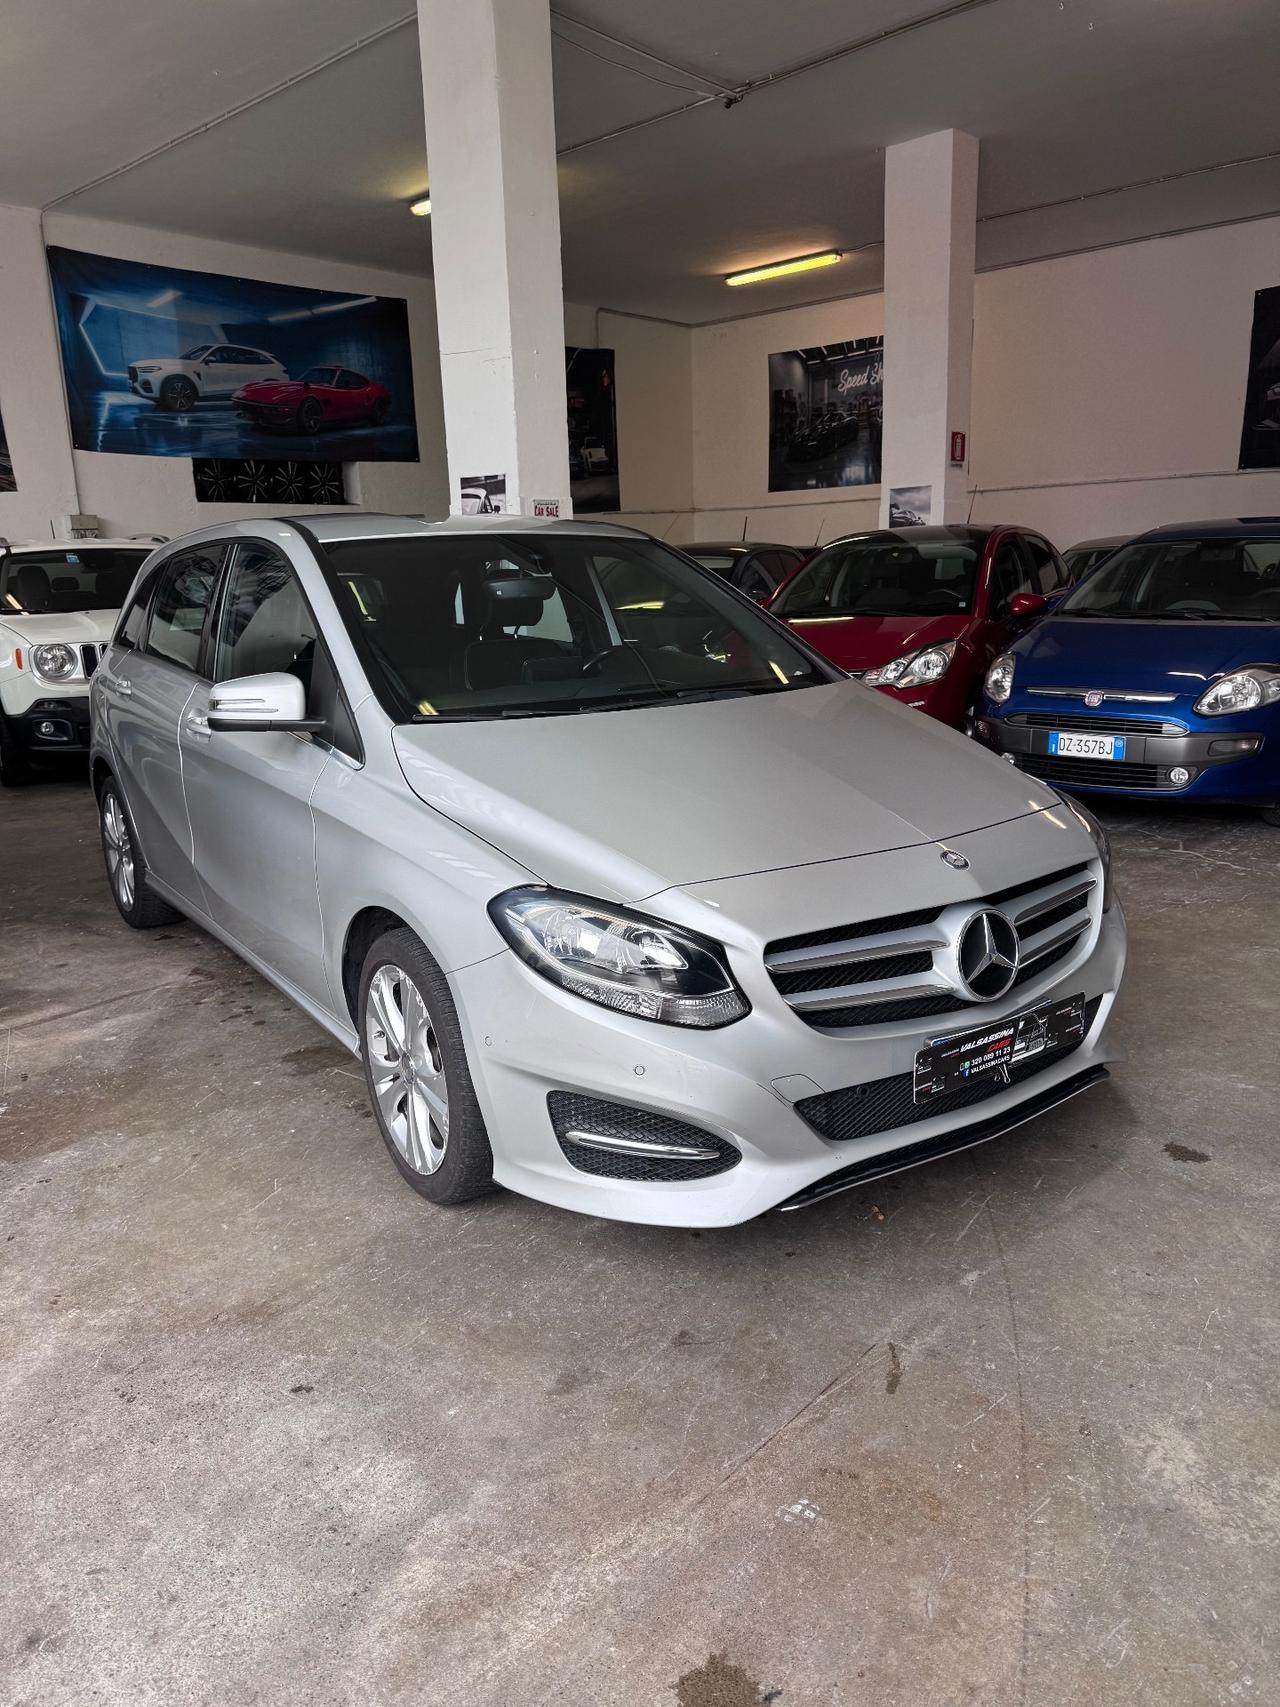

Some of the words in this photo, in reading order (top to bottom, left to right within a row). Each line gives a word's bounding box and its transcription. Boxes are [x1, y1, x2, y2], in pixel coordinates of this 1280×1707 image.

[838, 366, 870, 396] Speed
[546, 505, 559, 518] SALE
[960, 1027, 1014, 1053] VALSASSINA
[995, 1049, 1002, 1057] 11
